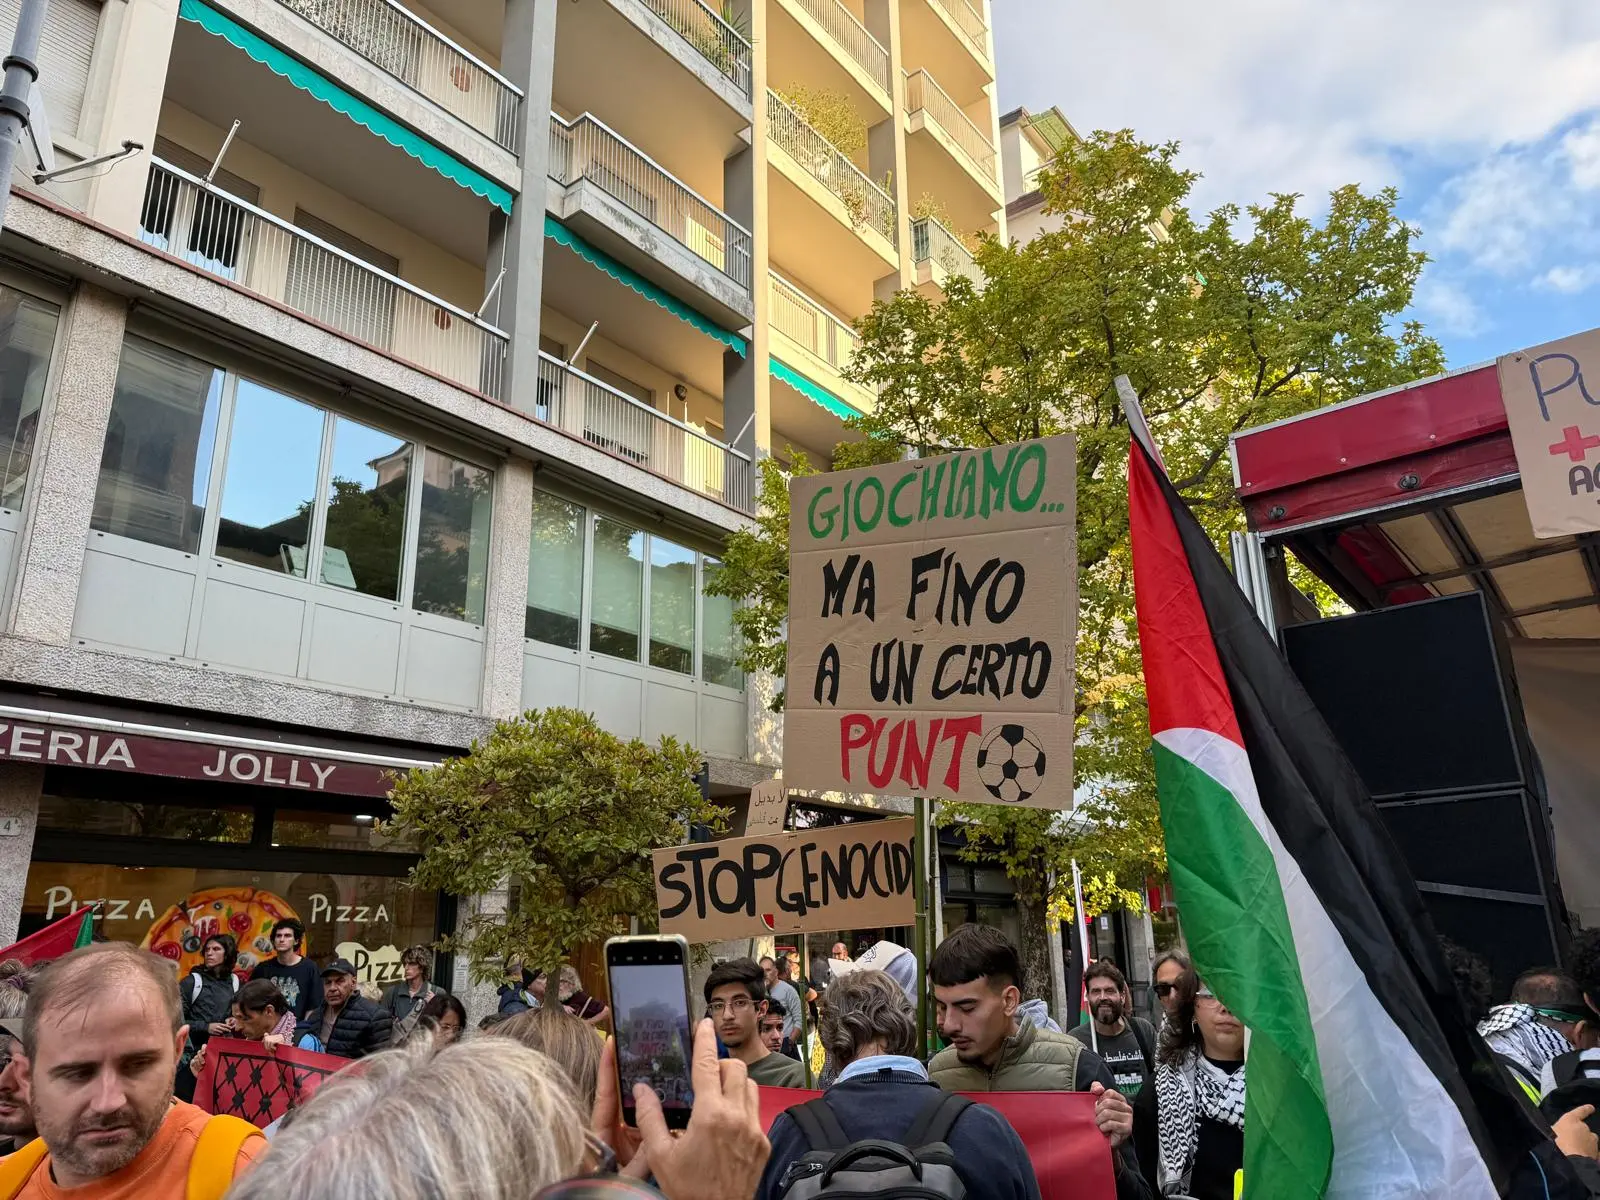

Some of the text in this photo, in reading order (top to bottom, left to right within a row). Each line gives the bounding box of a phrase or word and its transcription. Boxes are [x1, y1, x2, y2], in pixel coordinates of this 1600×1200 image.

[807, 443, 1065, 541] GIOCHIAMO...
[1568, 463, 1600, 496] A
[820, 547, 1025, 627] MA FINO
[814, 637, 1052, 706] A UN CERTO
[0, 723, 337, 790] ERIA JOLLY
[308, 893, 389, 924] PIZZA
[659, 836, 916, 919] STOP GENOCID
